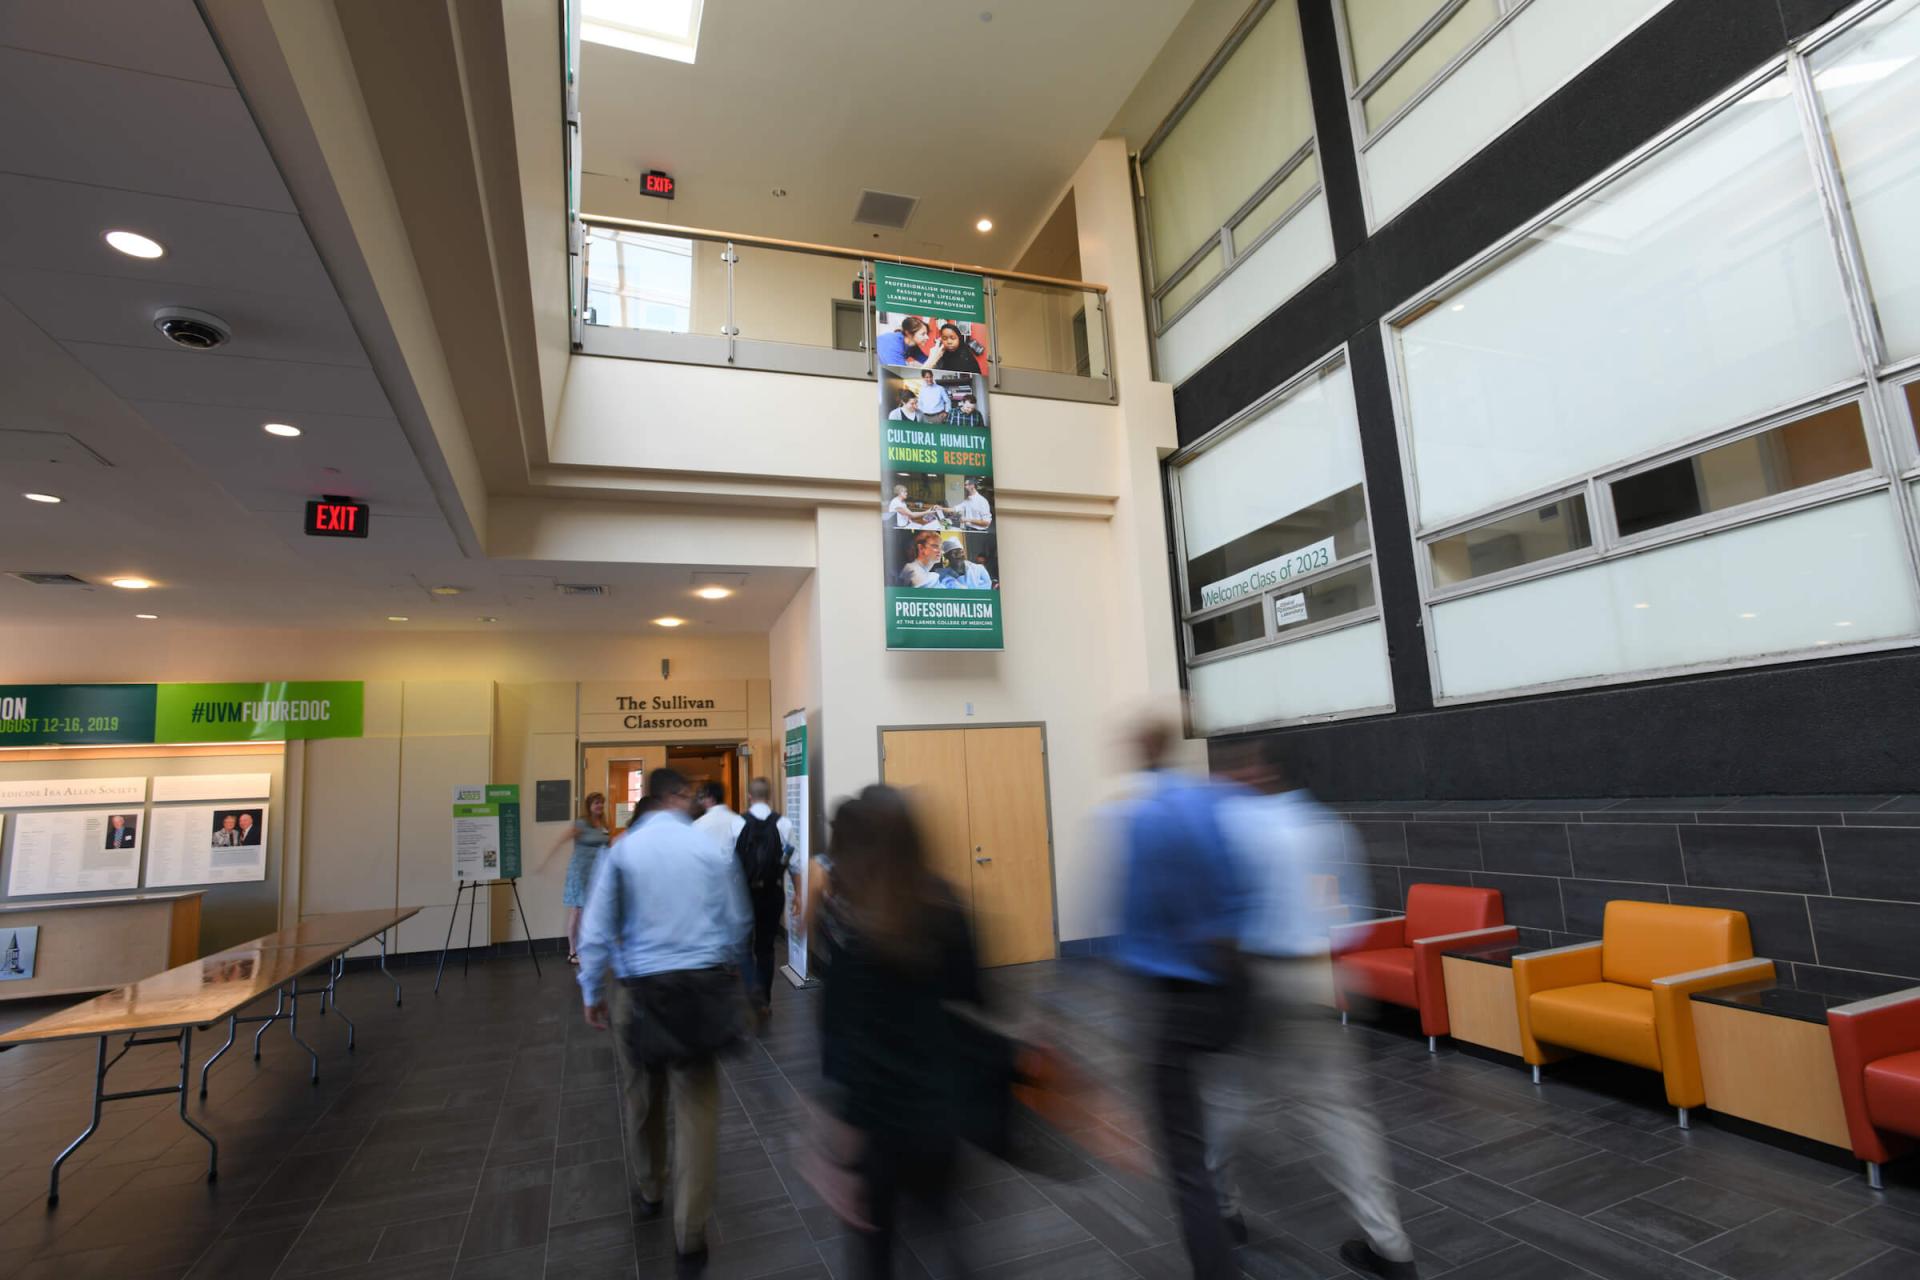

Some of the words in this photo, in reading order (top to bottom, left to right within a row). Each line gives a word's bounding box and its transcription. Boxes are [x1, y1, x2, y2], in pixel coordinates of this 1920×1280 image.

[647, 175, 670, 193] EXIT
[884, 280, 939, 293] PROFESSIONALISM
[939, 286, 962, 296] GUIDES
[896, 288, 922, 297] PASSION
[923, 291, 936, 299] FOR
[937, 293, 965, 302] LIFELONG
[886, 294, 918, 303] LEARNING
[933, 299, 975, 309] IMPROVEMENT
[887, 428, 937, 446] CULTURAL
[940, 432, 986, 450] HUMILITY
[888, 447, 938, 464] KINDNESS
[943, 451, 986, 467] RESPECT
[316, 504, 358, 531] EXIT
[1202, 581, 1249, 607] Welcome
[1249, 573, 1277, 591] Class
[1279, 560, 1293, 580] of
[1296, 547, 1329, 574] 2023
[895, 601, 993, 619] PROFESSIONALISM
[191, 699, 331, 724] #UVMFUTUREDOC
[616, 695, 648, 711] The
[652, 695, 715, 710] Sullivan
[42, 717, 83, 734] 12-16,
[87, 716, 119, 732] 2019
[624, 714, 709, 730] Classroom
